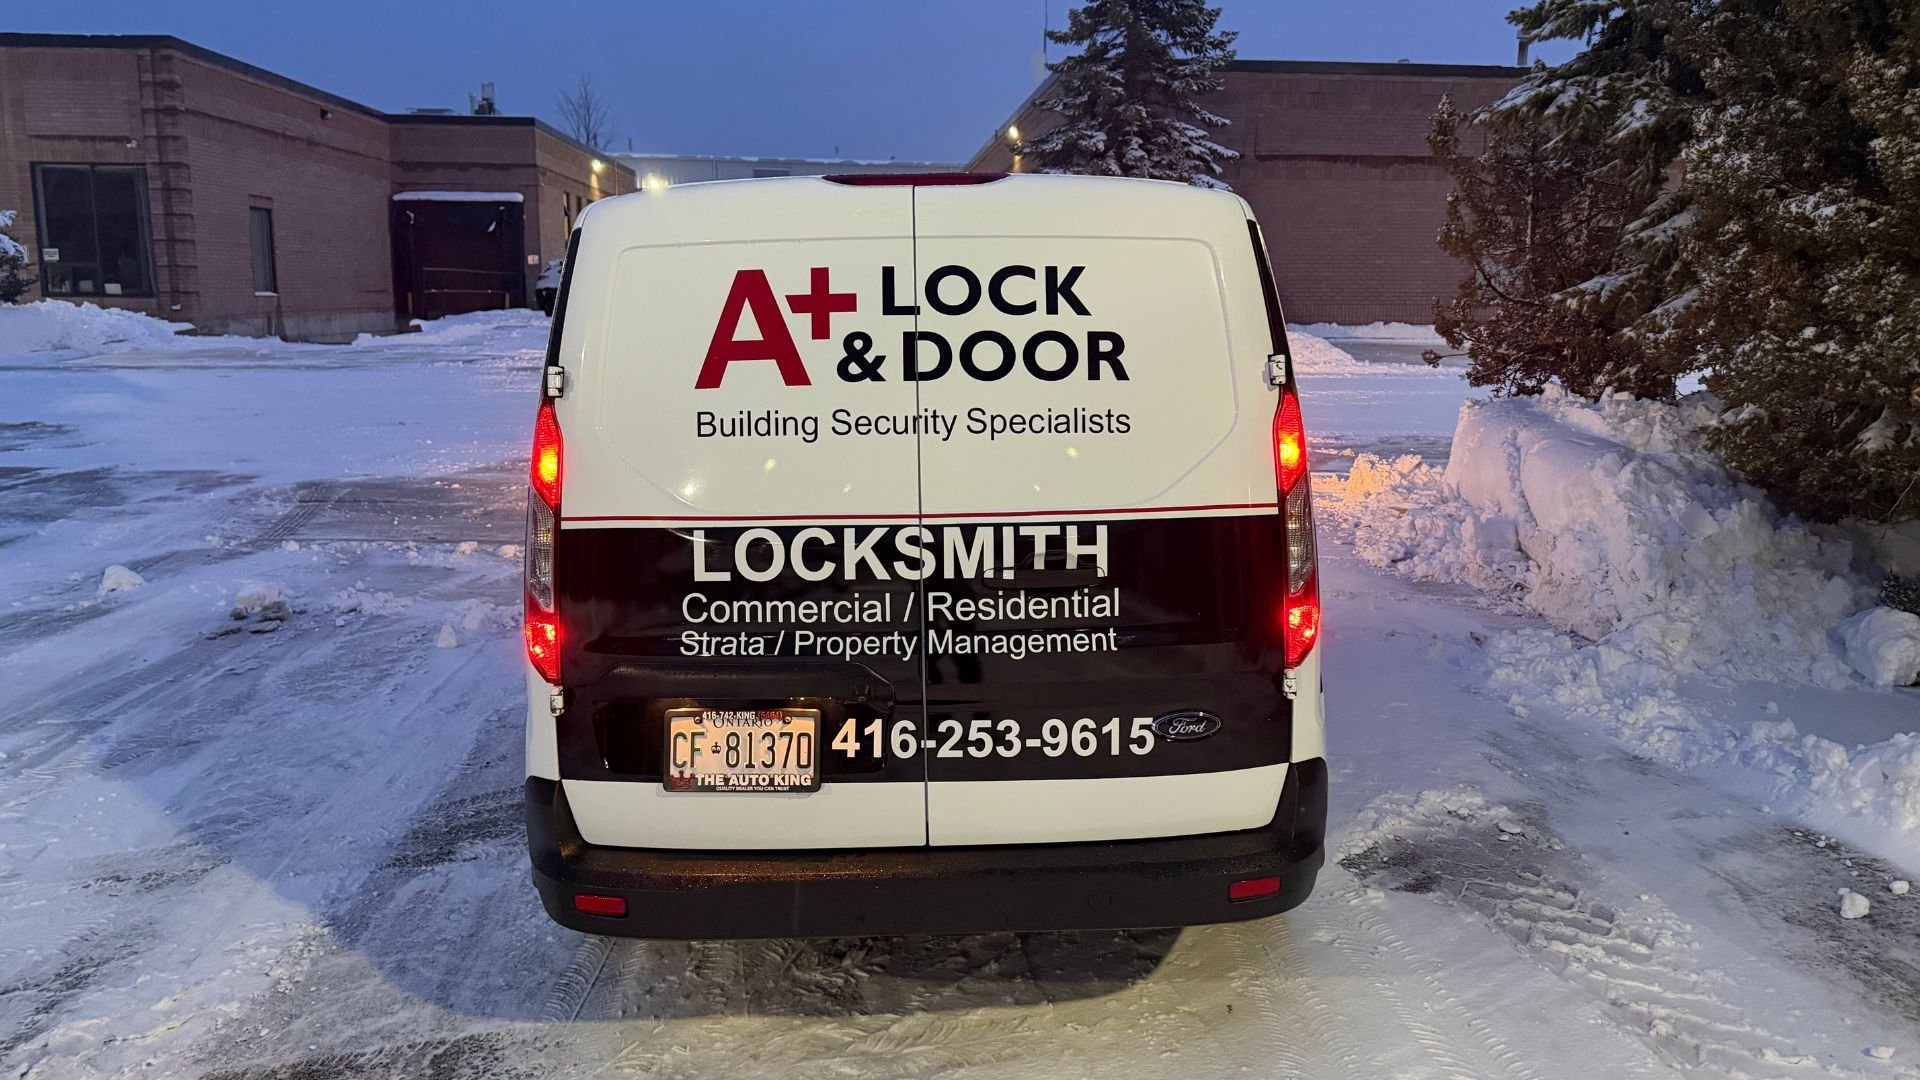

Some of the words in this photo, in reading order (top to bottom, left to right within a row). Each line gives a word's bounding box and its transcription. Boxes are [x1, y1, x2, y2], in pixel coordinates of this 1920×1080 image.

[695, 267, 857, 389] A+
[881, 264, 1092, 316] LOCK
[836, 331, 886, 382] &
[902, 330, 1130, 381] DOOR
[696, 410, 819, 442] Building
[831, 408, 957, 441] Security
[966, 407, 1131, 439] Specialists
[693, 524, 1108, 582] LOCKSMITH
[682, 592, 891, 623] Commercial
[903, 592, 915, 622] /
[928, 588, 1120, 621] Residential
[680, 630, 765, 656] Strata
[774, 629, 785, 656] /
[794, 629, 917, 662] Property
[928, 627, 1118, 660] Management
[702, 711, 756, 720] 416-742-KING
[1168, 718, 1206, 735] Ford
[725, 731, 812, 769] 81370
[831, 717, 1155, 759] 416-253-9615
[696, 774, 724, 786] THE
[728, 774, 770, 786] AUTO
[774, 774, 811, 786] KING
